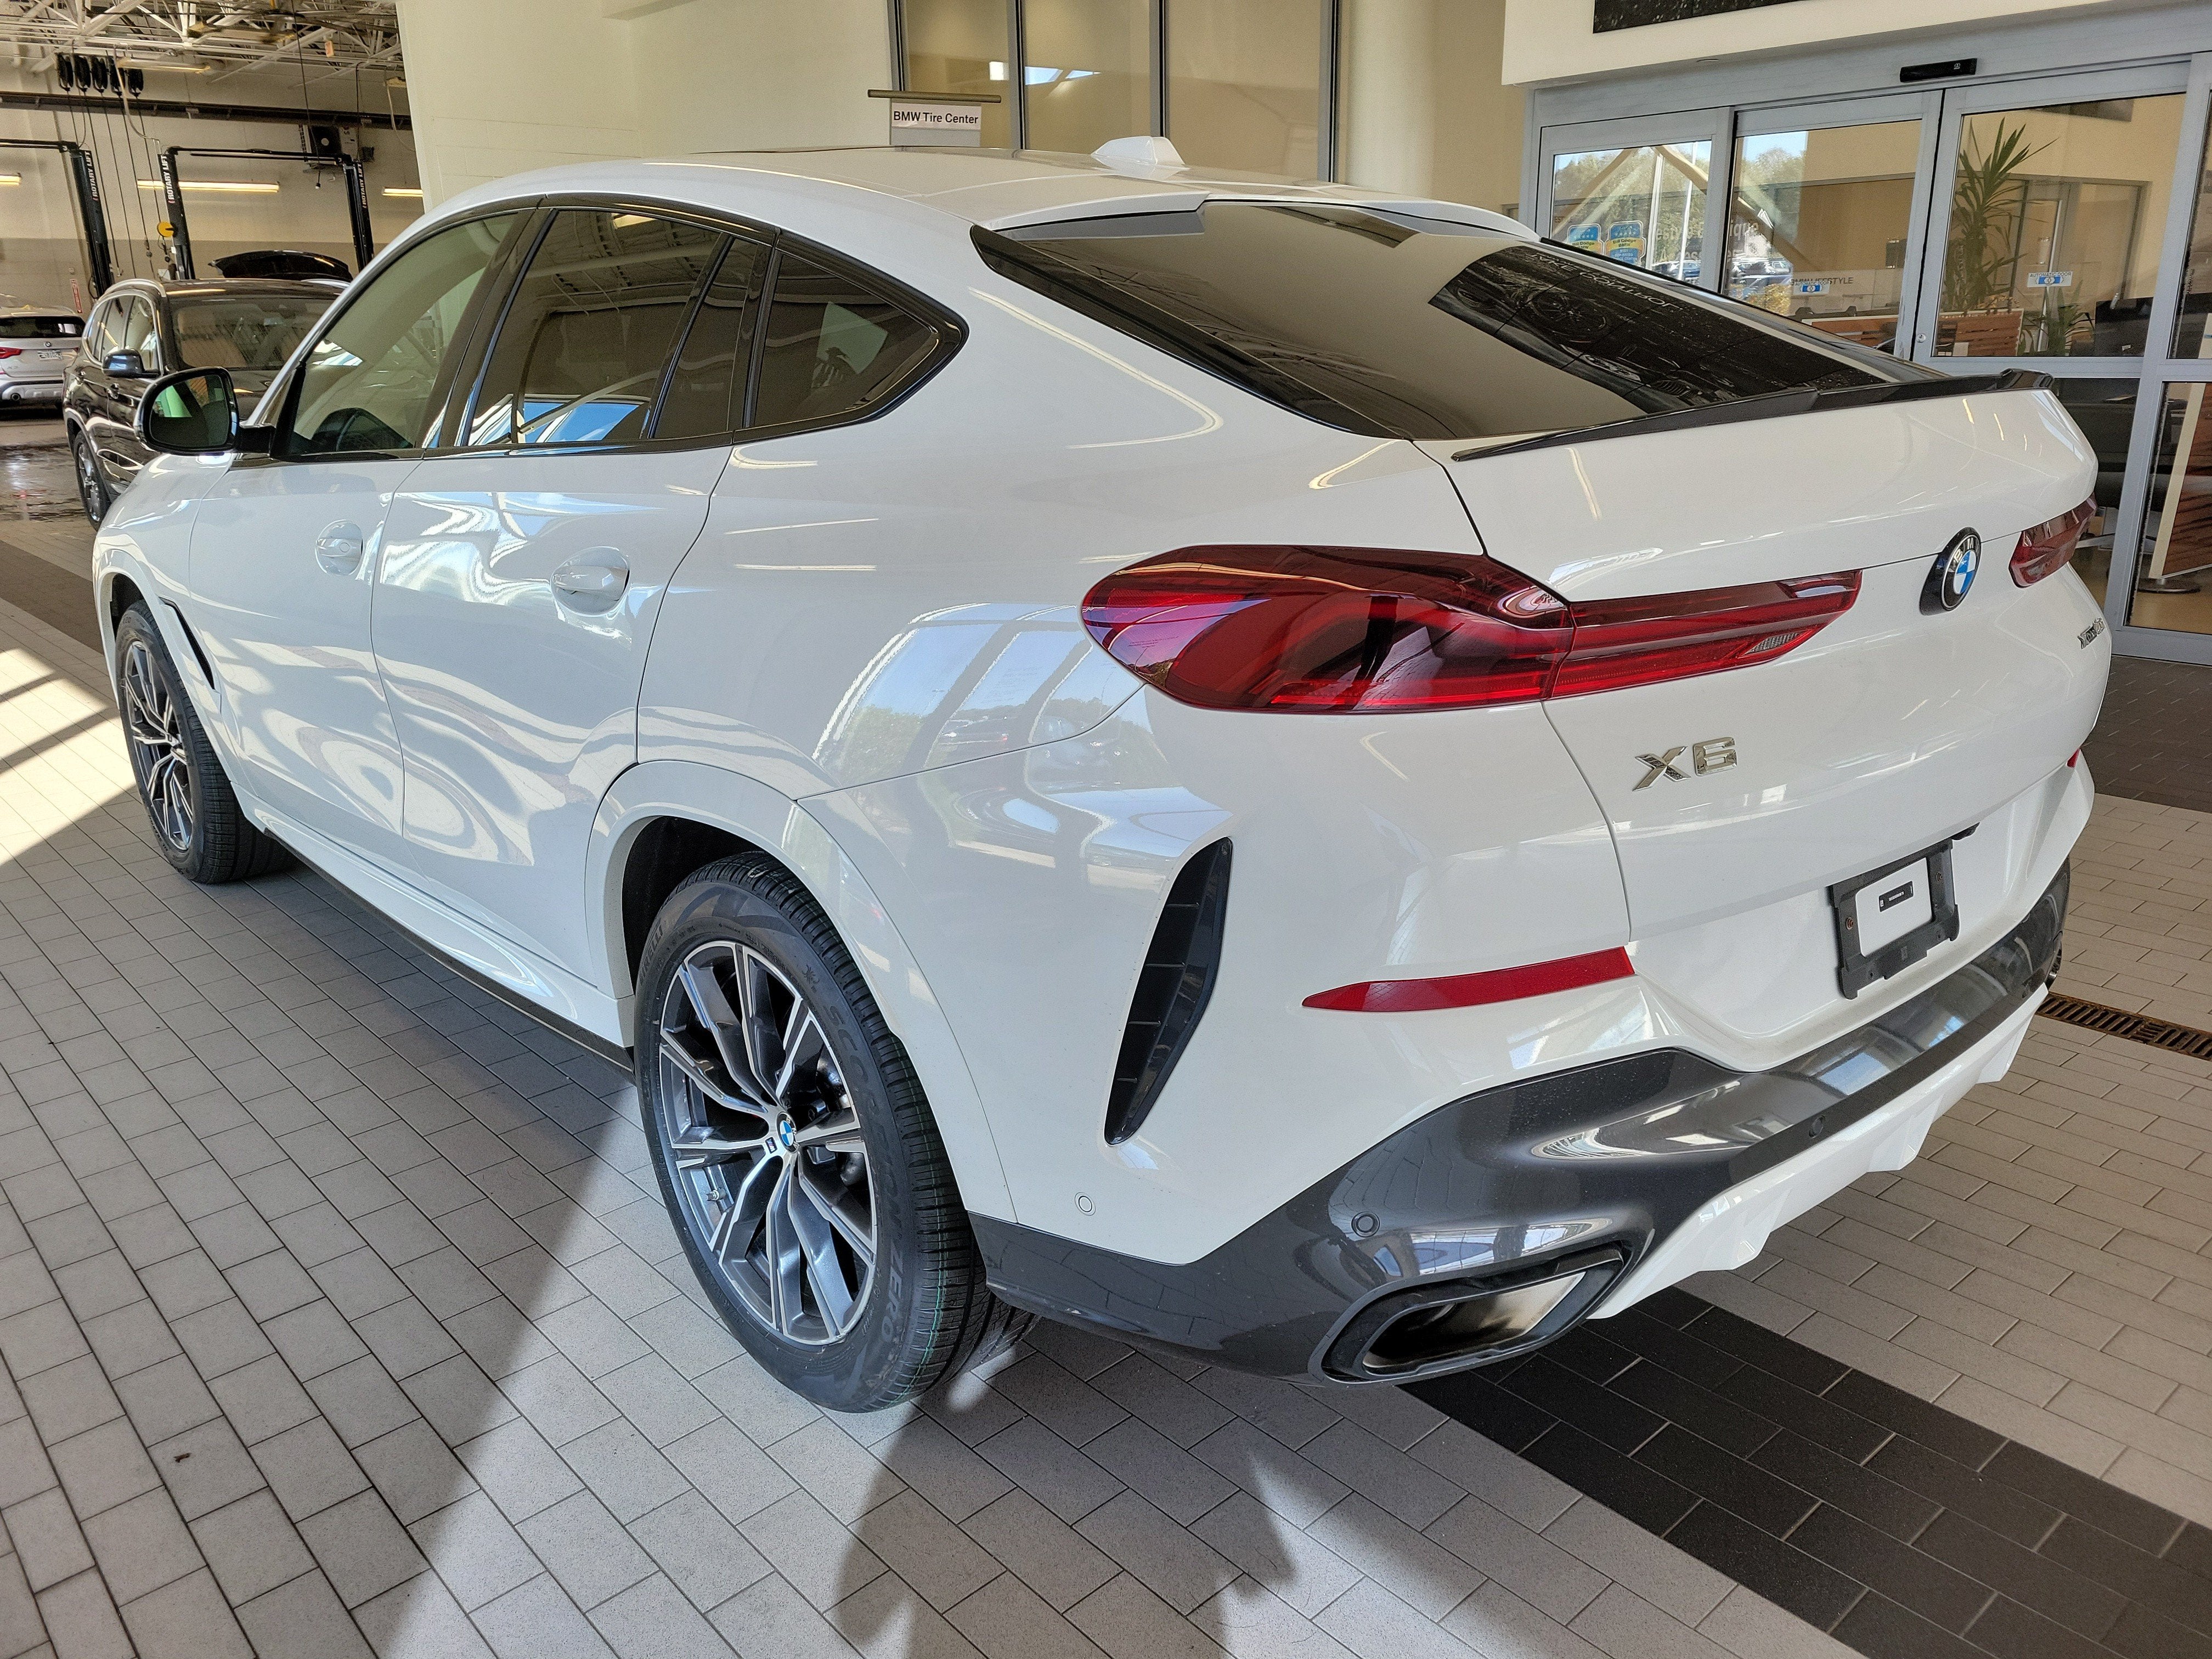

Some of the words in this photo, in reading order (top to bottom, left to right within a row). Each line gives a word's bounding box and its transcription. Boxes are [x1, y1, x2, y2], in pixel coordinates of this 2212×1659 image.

[894, 111, 921, 121] BMW
[923, 112, 943, 122] Tire
[945, 113, 979, 123] Center
[160, 155, 170, 170] LIFT
[88, 168, 98, 197] ROTARY
[163, 171, 176, 200] ROTARY
[1632, 736, 1738, 792] X6
[881, 1243, 904, 1343] ZERO
